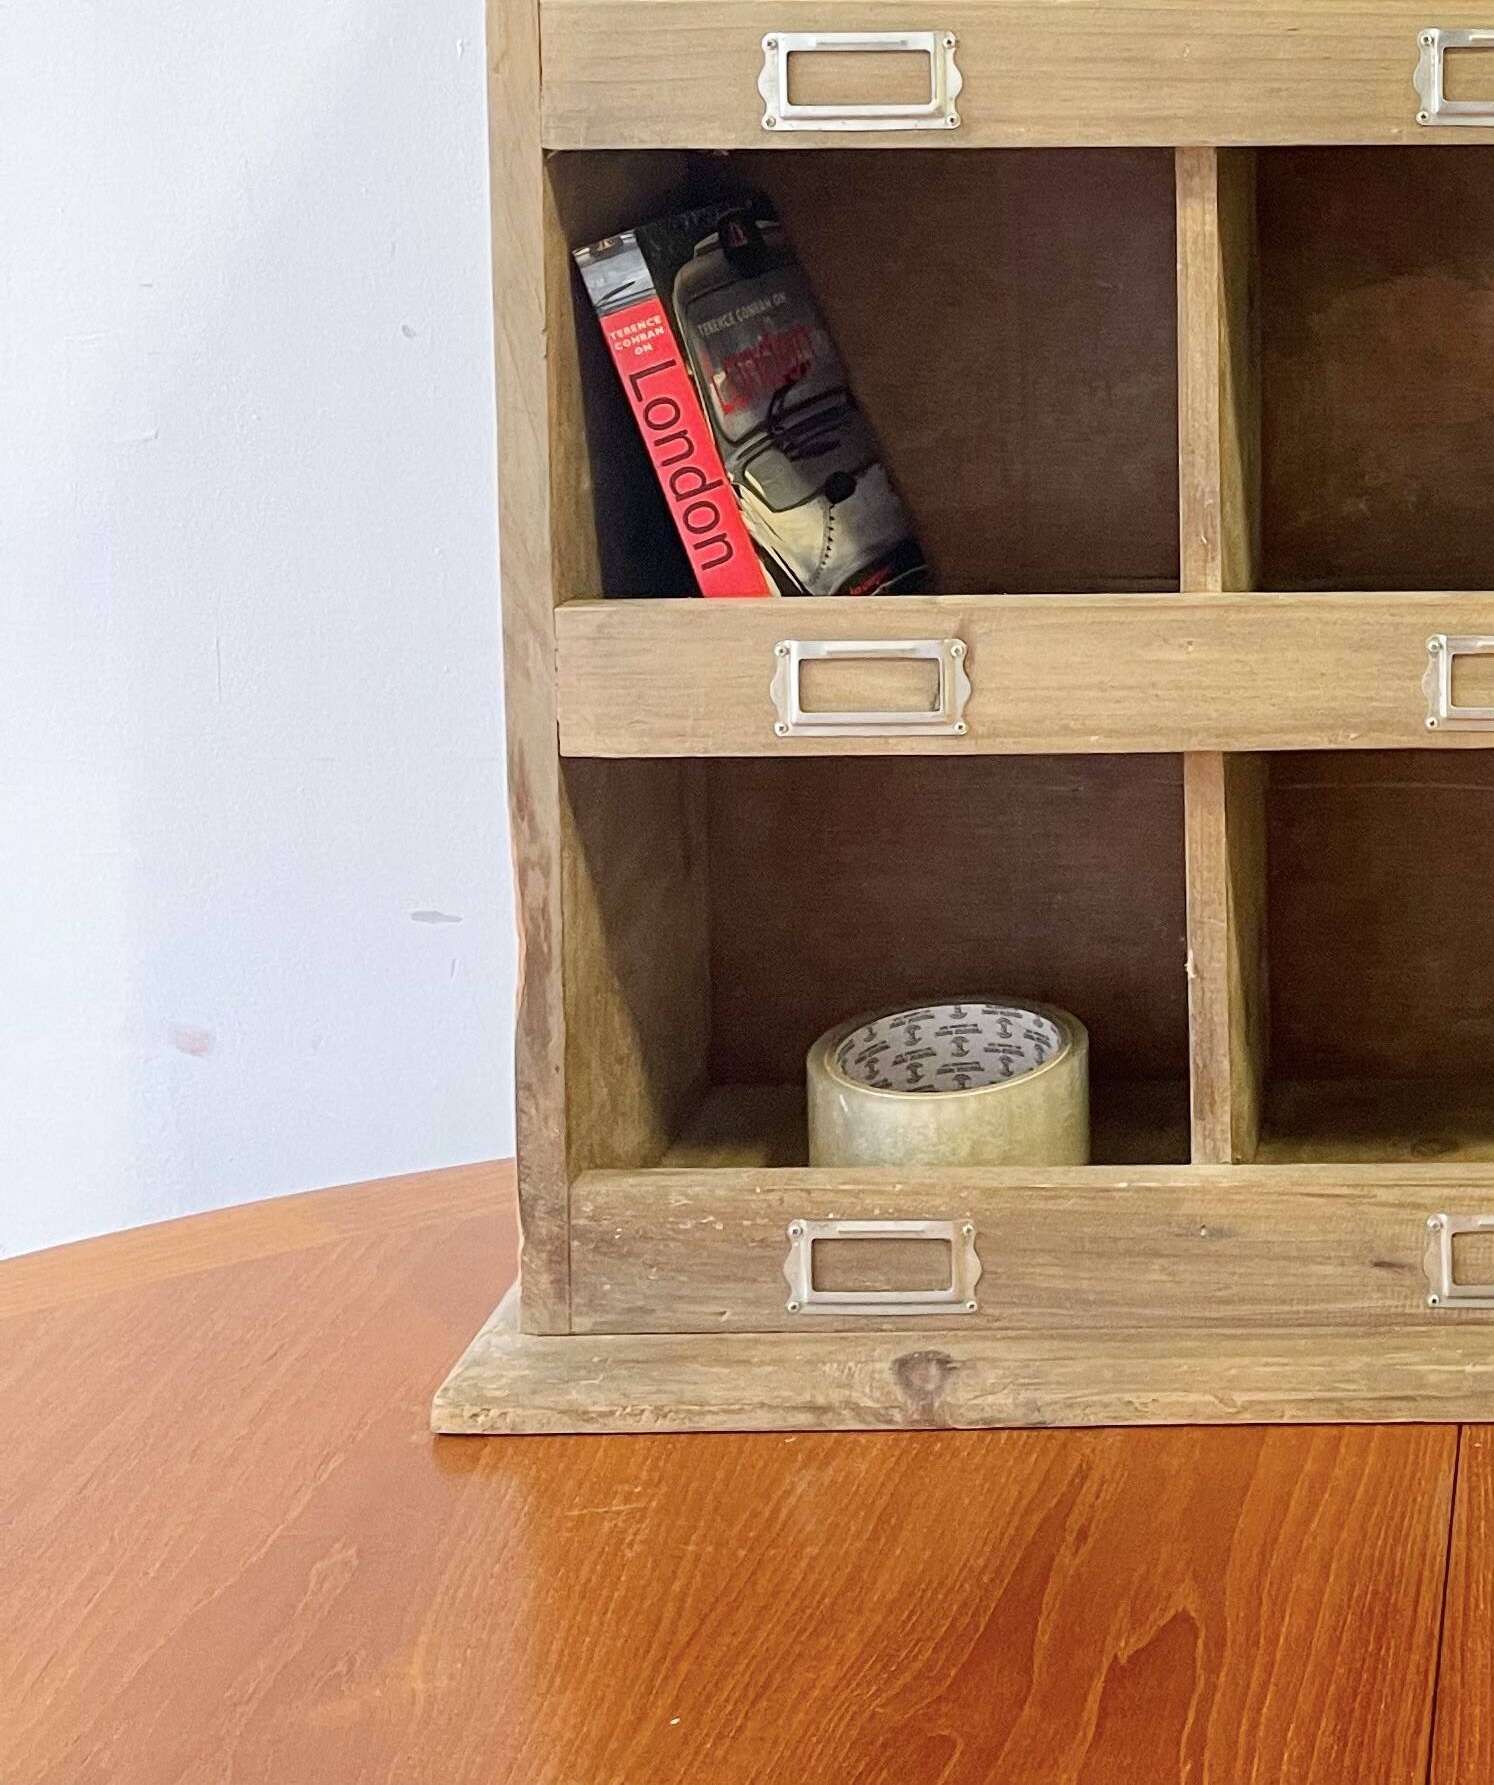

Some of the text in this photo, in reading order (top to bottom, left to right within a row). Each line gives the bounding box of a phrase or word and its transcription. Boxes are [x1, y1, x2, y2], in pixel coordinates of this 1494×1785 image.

[609, 315, 662, 341] TERENCE
[614, 326, 665, 351] CONRAN
[634, 343, 653, 356] ON
[629, 358, 734, 571] London
